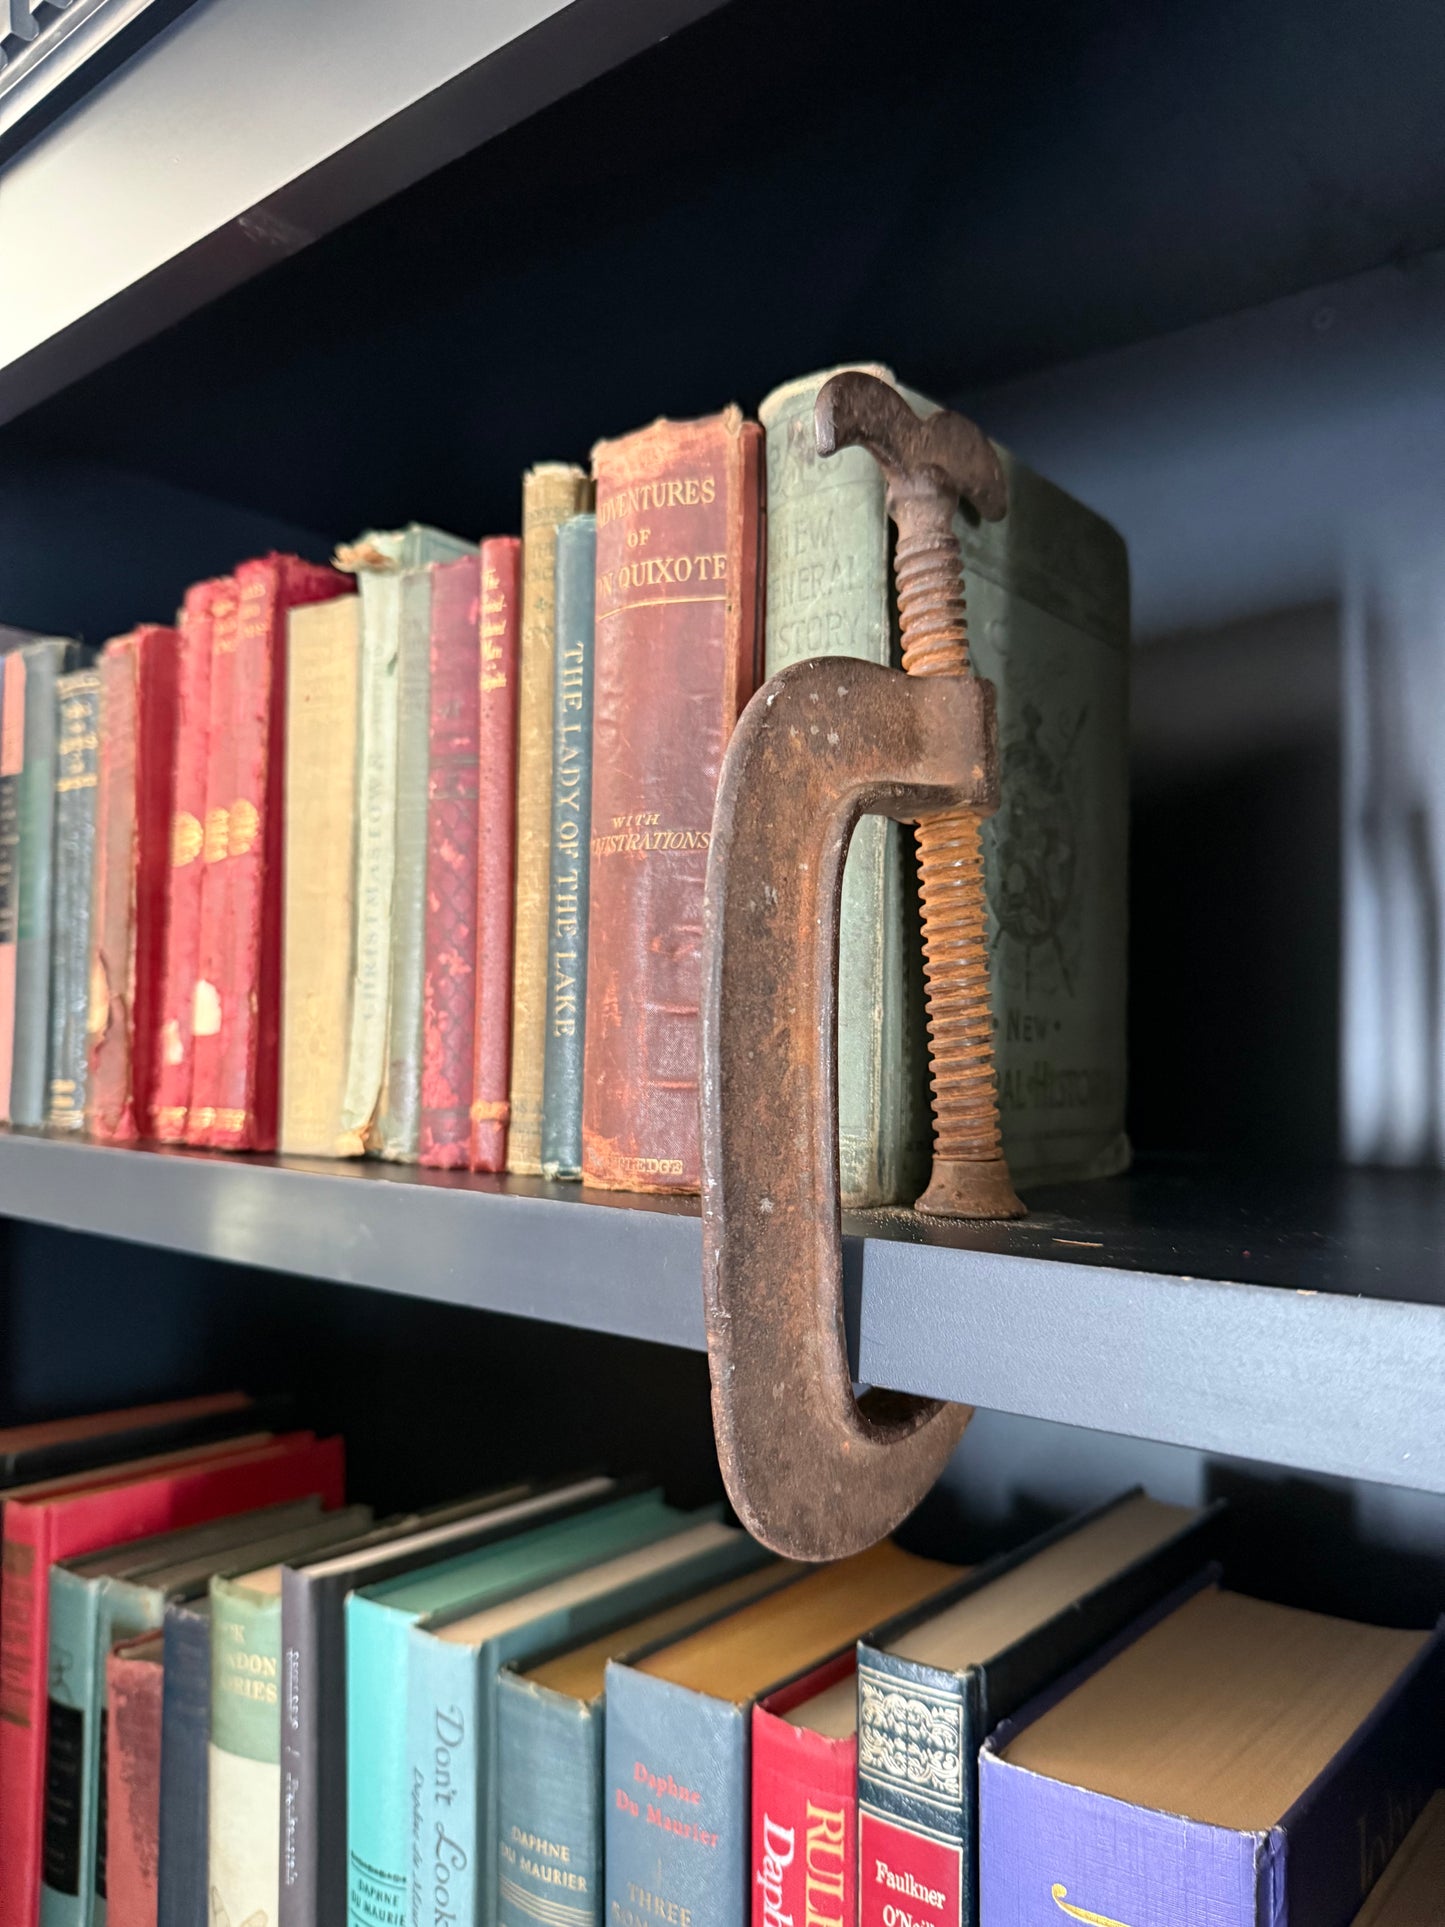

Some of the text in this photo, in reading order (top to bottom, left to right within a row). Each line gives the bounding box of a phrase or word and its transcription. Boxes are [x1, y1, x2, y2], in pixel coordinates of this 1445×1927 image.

[627, 527, 652, 549] OF
[618, 553, 728, 592] QUIXOTE
[553, 641, 586, 1038] THE LADY OF THE LAKE
[612, 813, 661, 829] WITH
[435, 1704, 465, 1806] Don't
[632, 1761, 702, 1806] Daphne
[615, 1788, 720, 1849] Du Maurier
[511, 1824, 571, 1863] DAPHNE
[358, 1879, 400, 1908] DAPHNE
[519, 1855, 588, 1893] MAURIER
[875, 1859, 947, 1910] Faulkner
[628, 1881, 692, 1927] THREE
